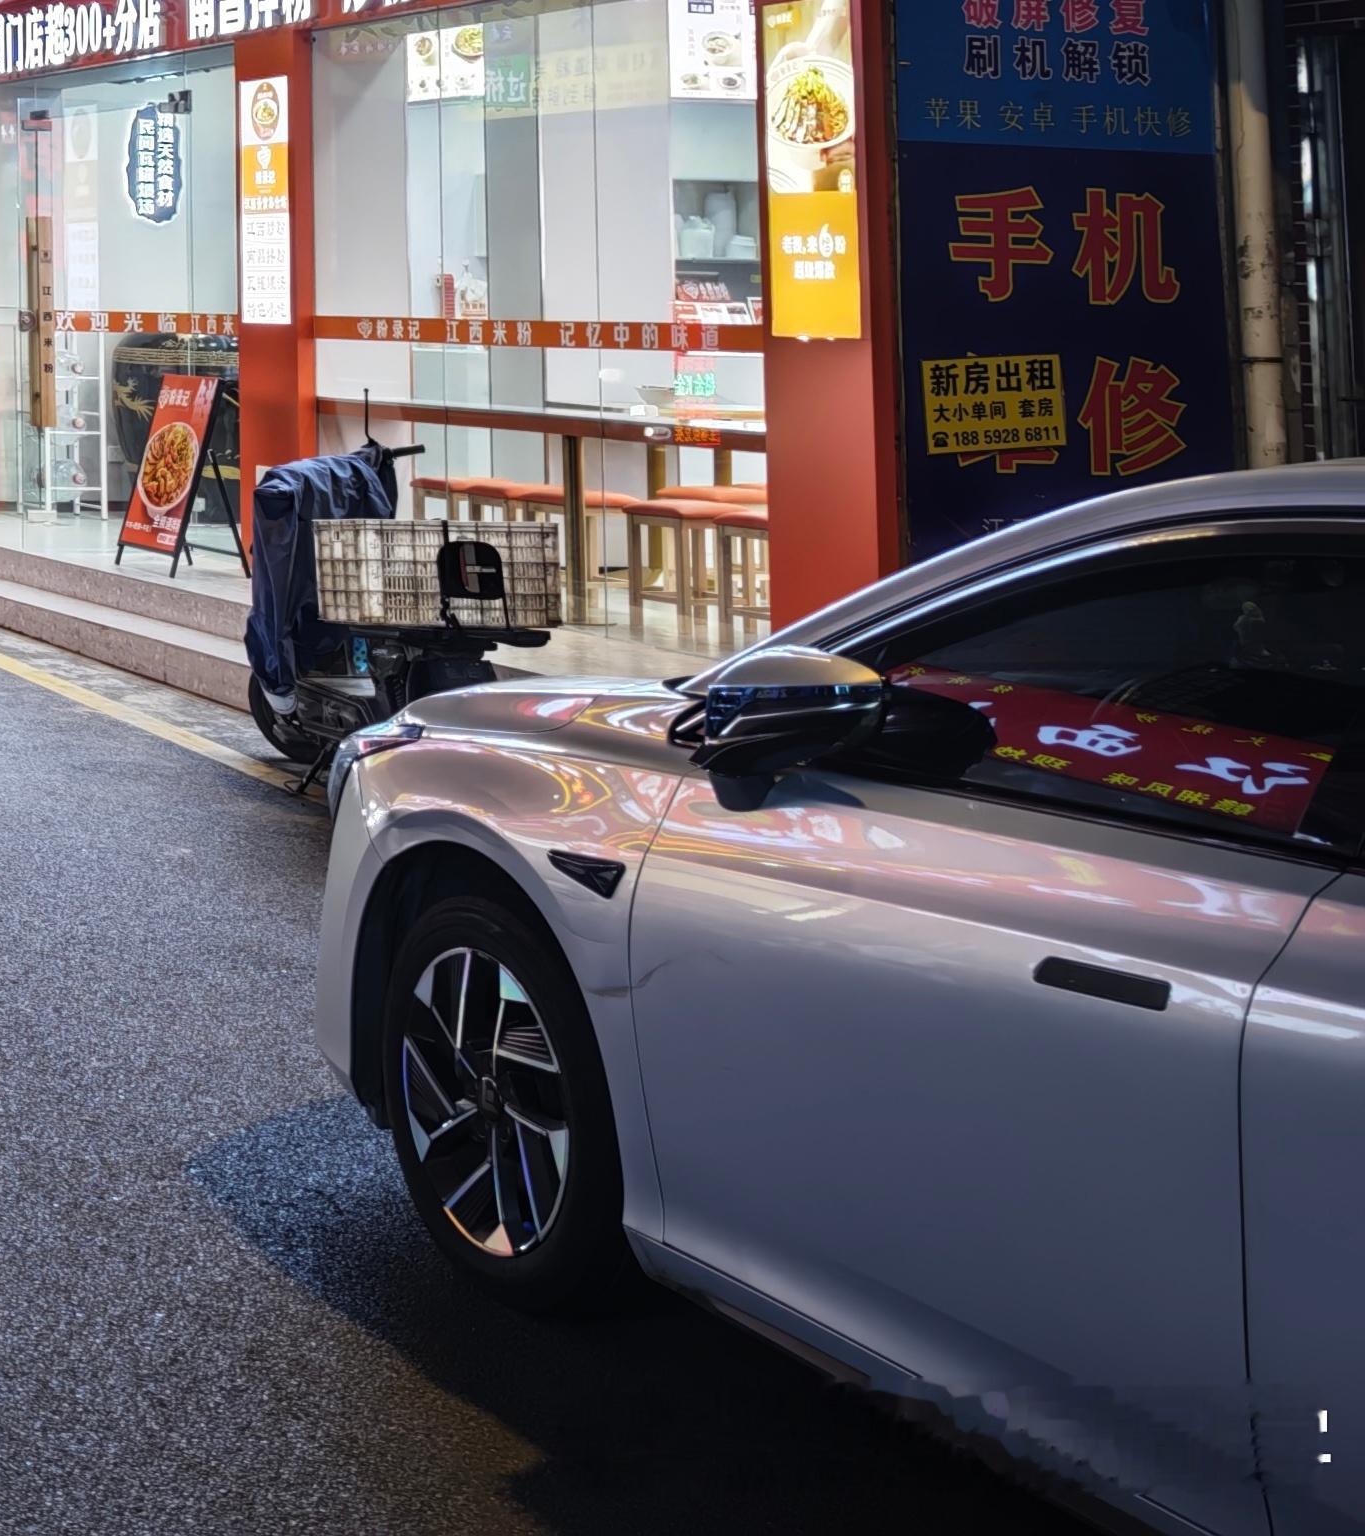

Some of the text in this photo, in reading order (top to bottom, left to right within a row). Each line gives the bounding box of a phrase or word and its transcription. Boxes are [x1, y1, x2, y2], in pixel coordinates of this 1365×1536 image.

[963, 35, 1151, 86] 刷机解锁
[923, 97, 1193, 138] 苹果 安卓 手机快修
[948, 185, 1181, 306] 手机
[42, 285, 54, 375] 江西米粉
[55, 312, 177, 333] 欢迎光临
[189, 314, 236, 336] 江西米
[375, 318, 722, 352] 粉录记 江西米粉 记忆中的味道
[929, 358, 1057, 397] 新房出租
[933, 397, 1054, 424] 大小单间 套房
[953, 425, 1061, 447] 188 5928 6811
